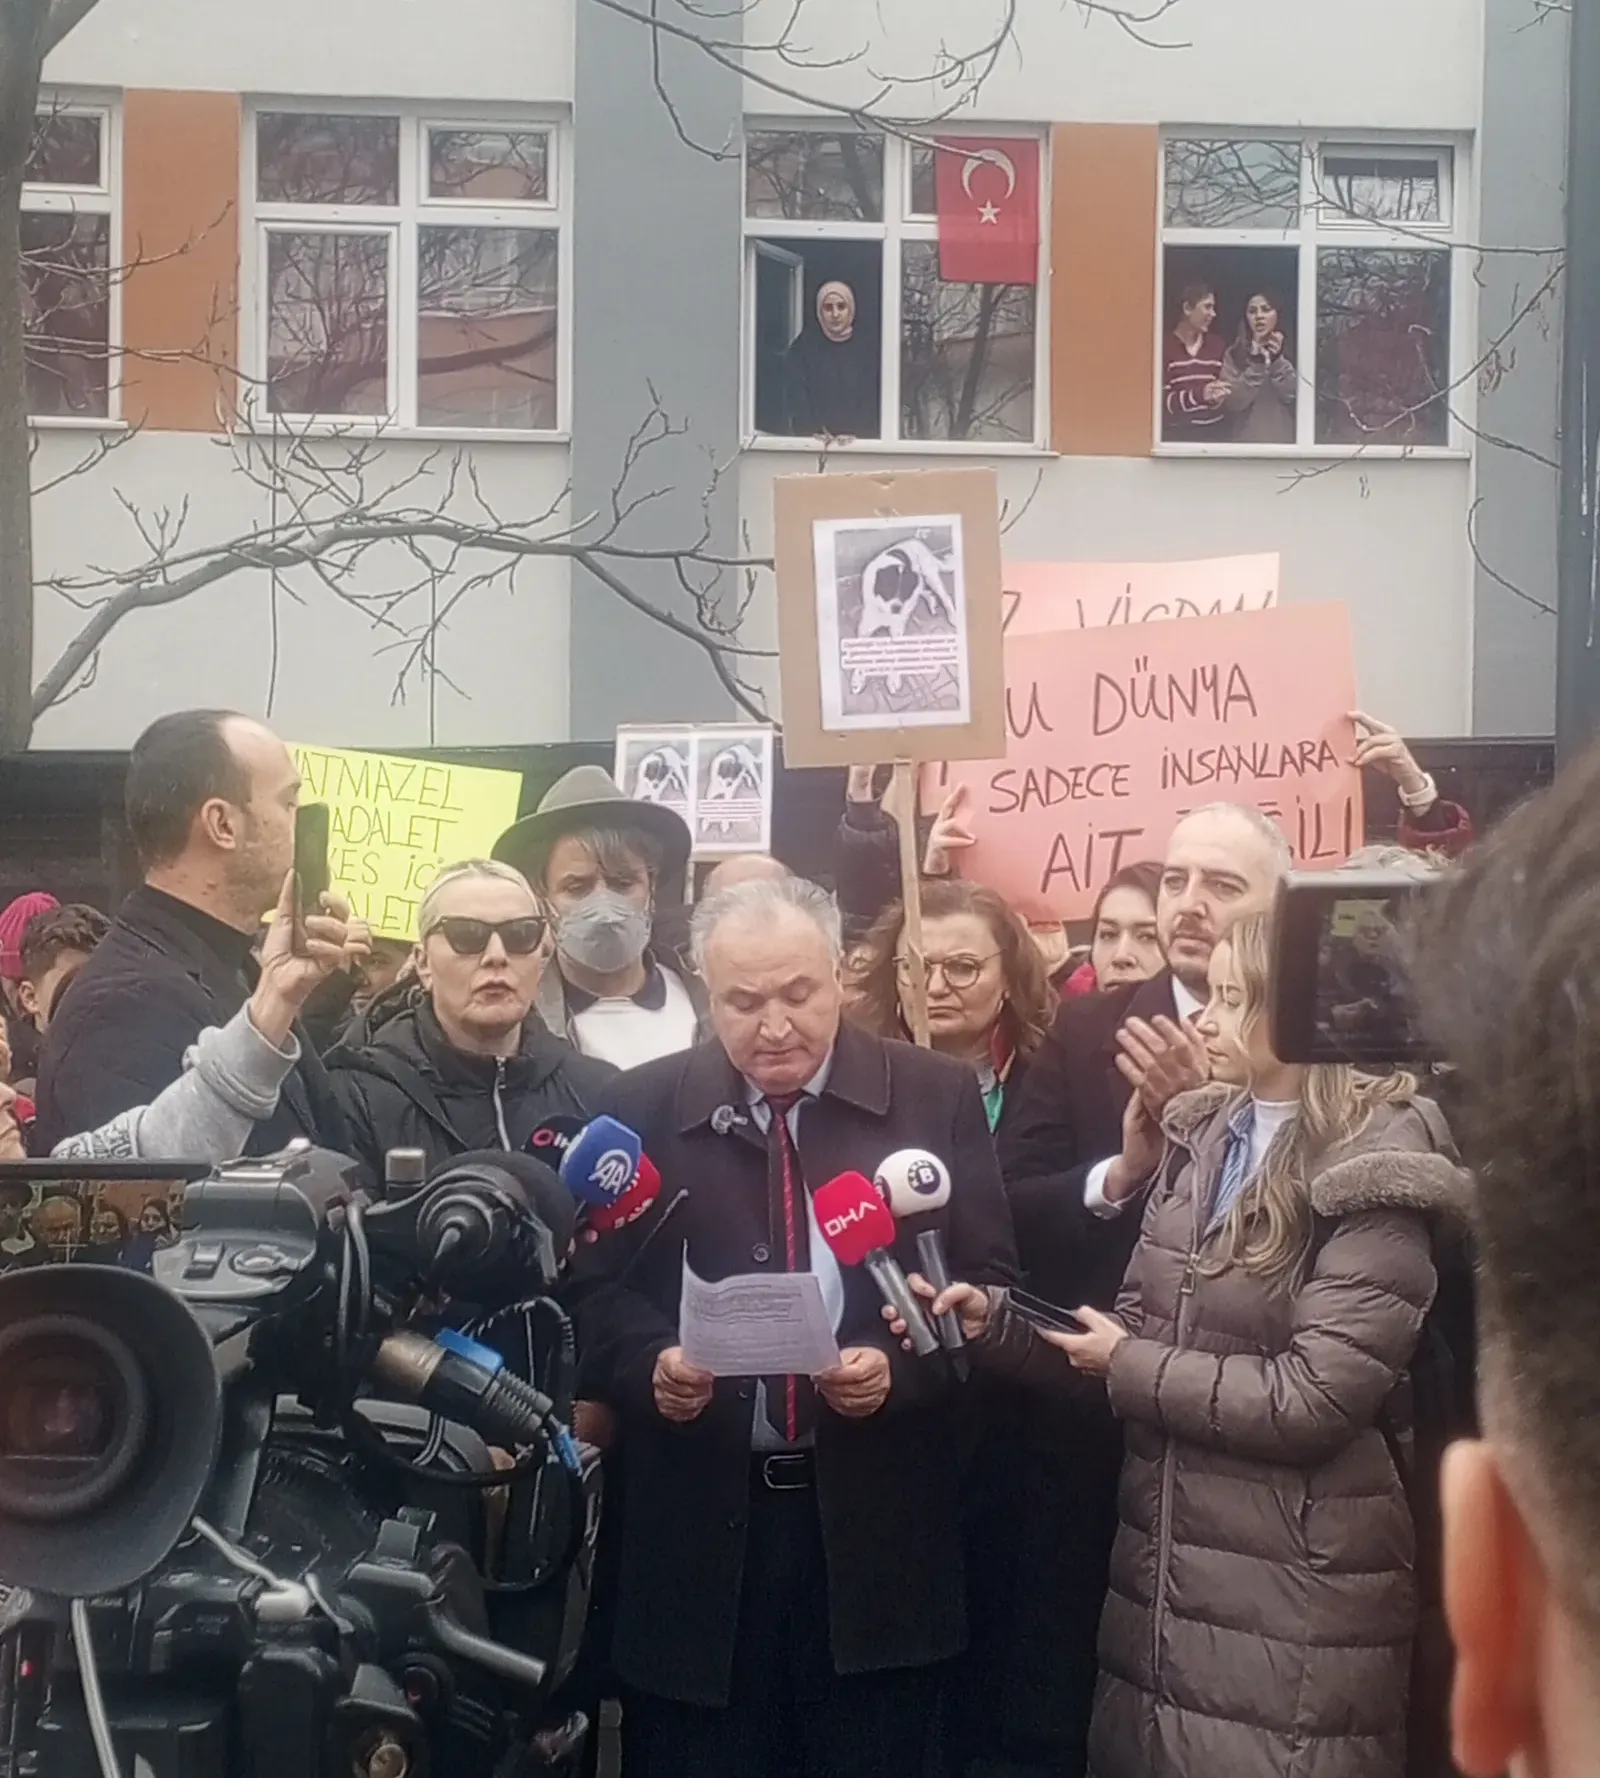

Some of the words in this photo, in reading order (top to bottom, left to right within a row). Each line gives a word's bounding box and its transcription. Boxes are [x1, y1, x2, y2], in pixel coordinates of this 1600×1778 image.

[1006, 681, 1054, 738] U
[1093, 655, 1258, 736] DÜNYA
[989, 763, 1131, 813] SADECE
[1161, 739, 1339, 790] İNSANLARA
[1040, 822, 1145, 894] AİT
